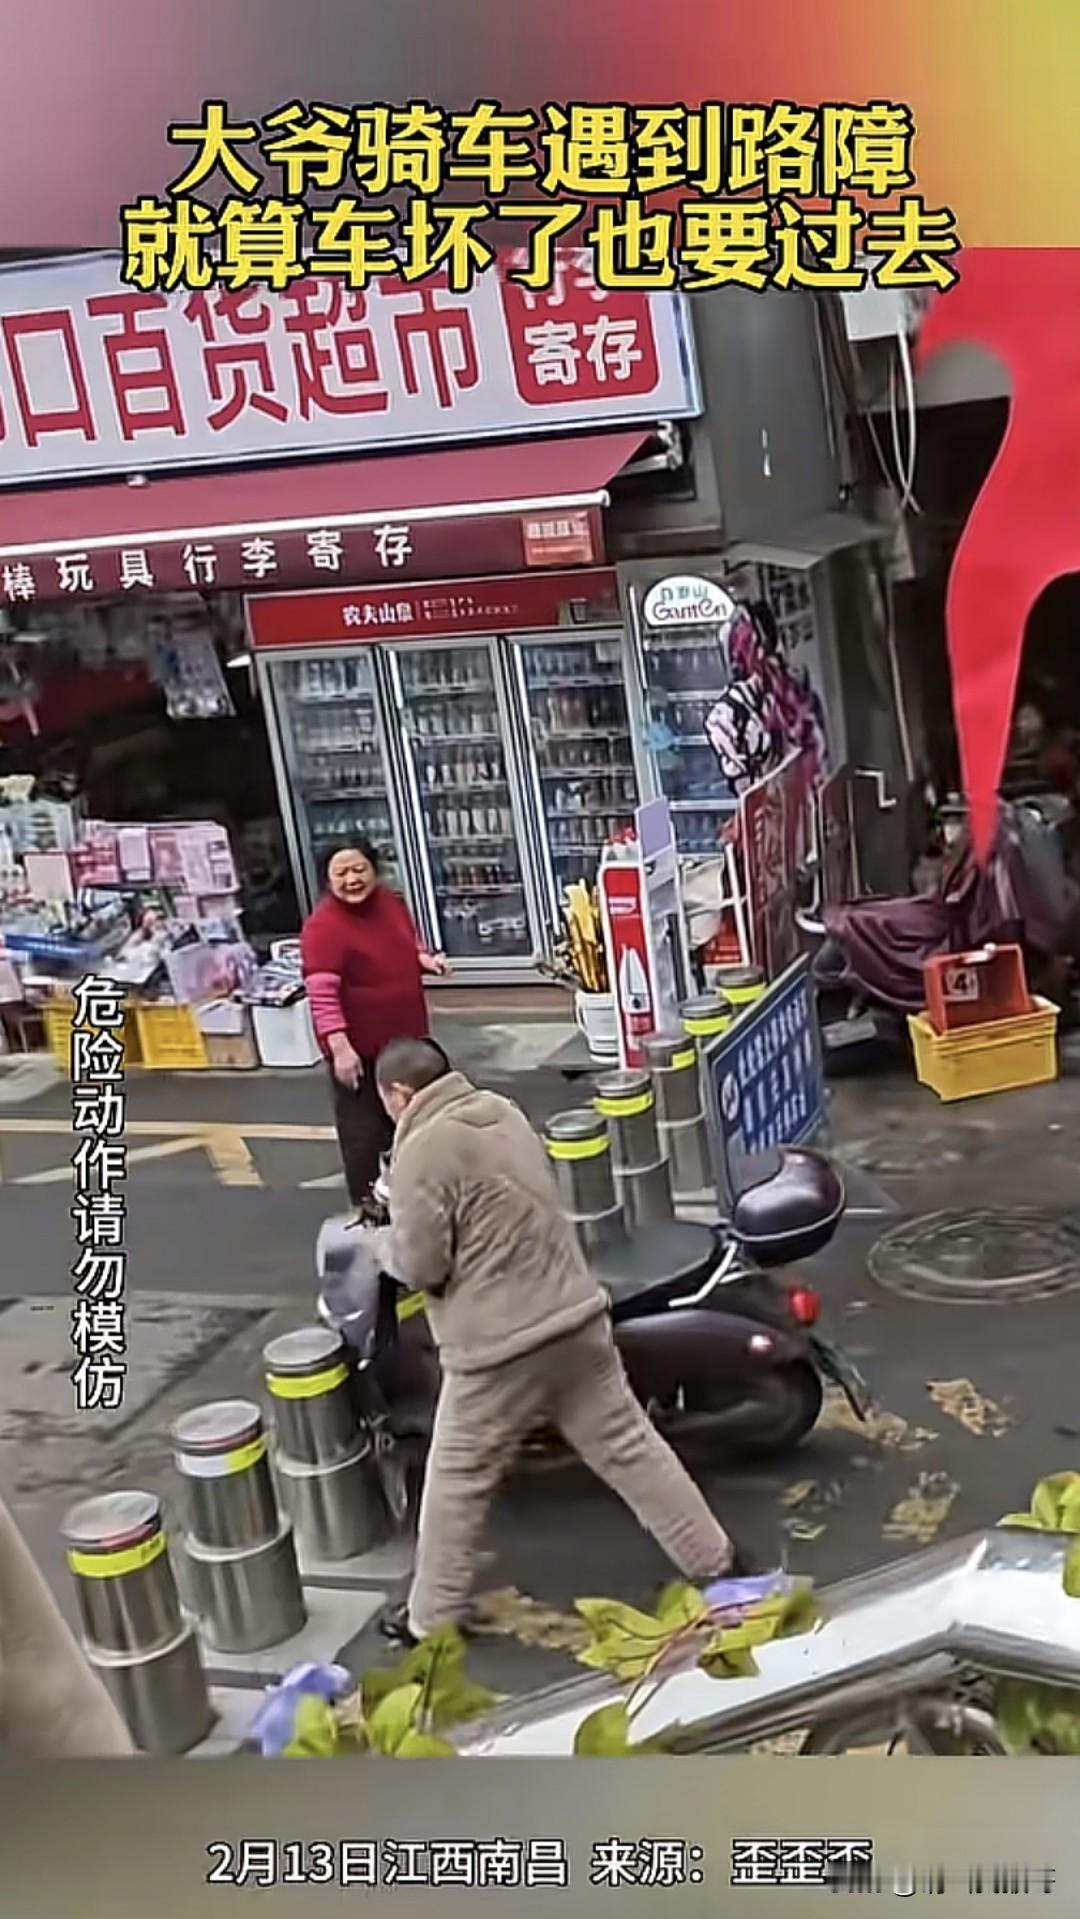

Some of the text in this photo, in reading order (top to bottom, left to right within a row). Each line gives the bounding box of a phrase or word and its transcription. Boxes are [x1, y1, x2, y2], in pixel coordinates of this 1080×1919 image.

[0, 271, 480, 447] 口百货超市
[524, 315, 643, 386] 寄存
[1, 524, 414, 602] 棒玩具行李寄存
